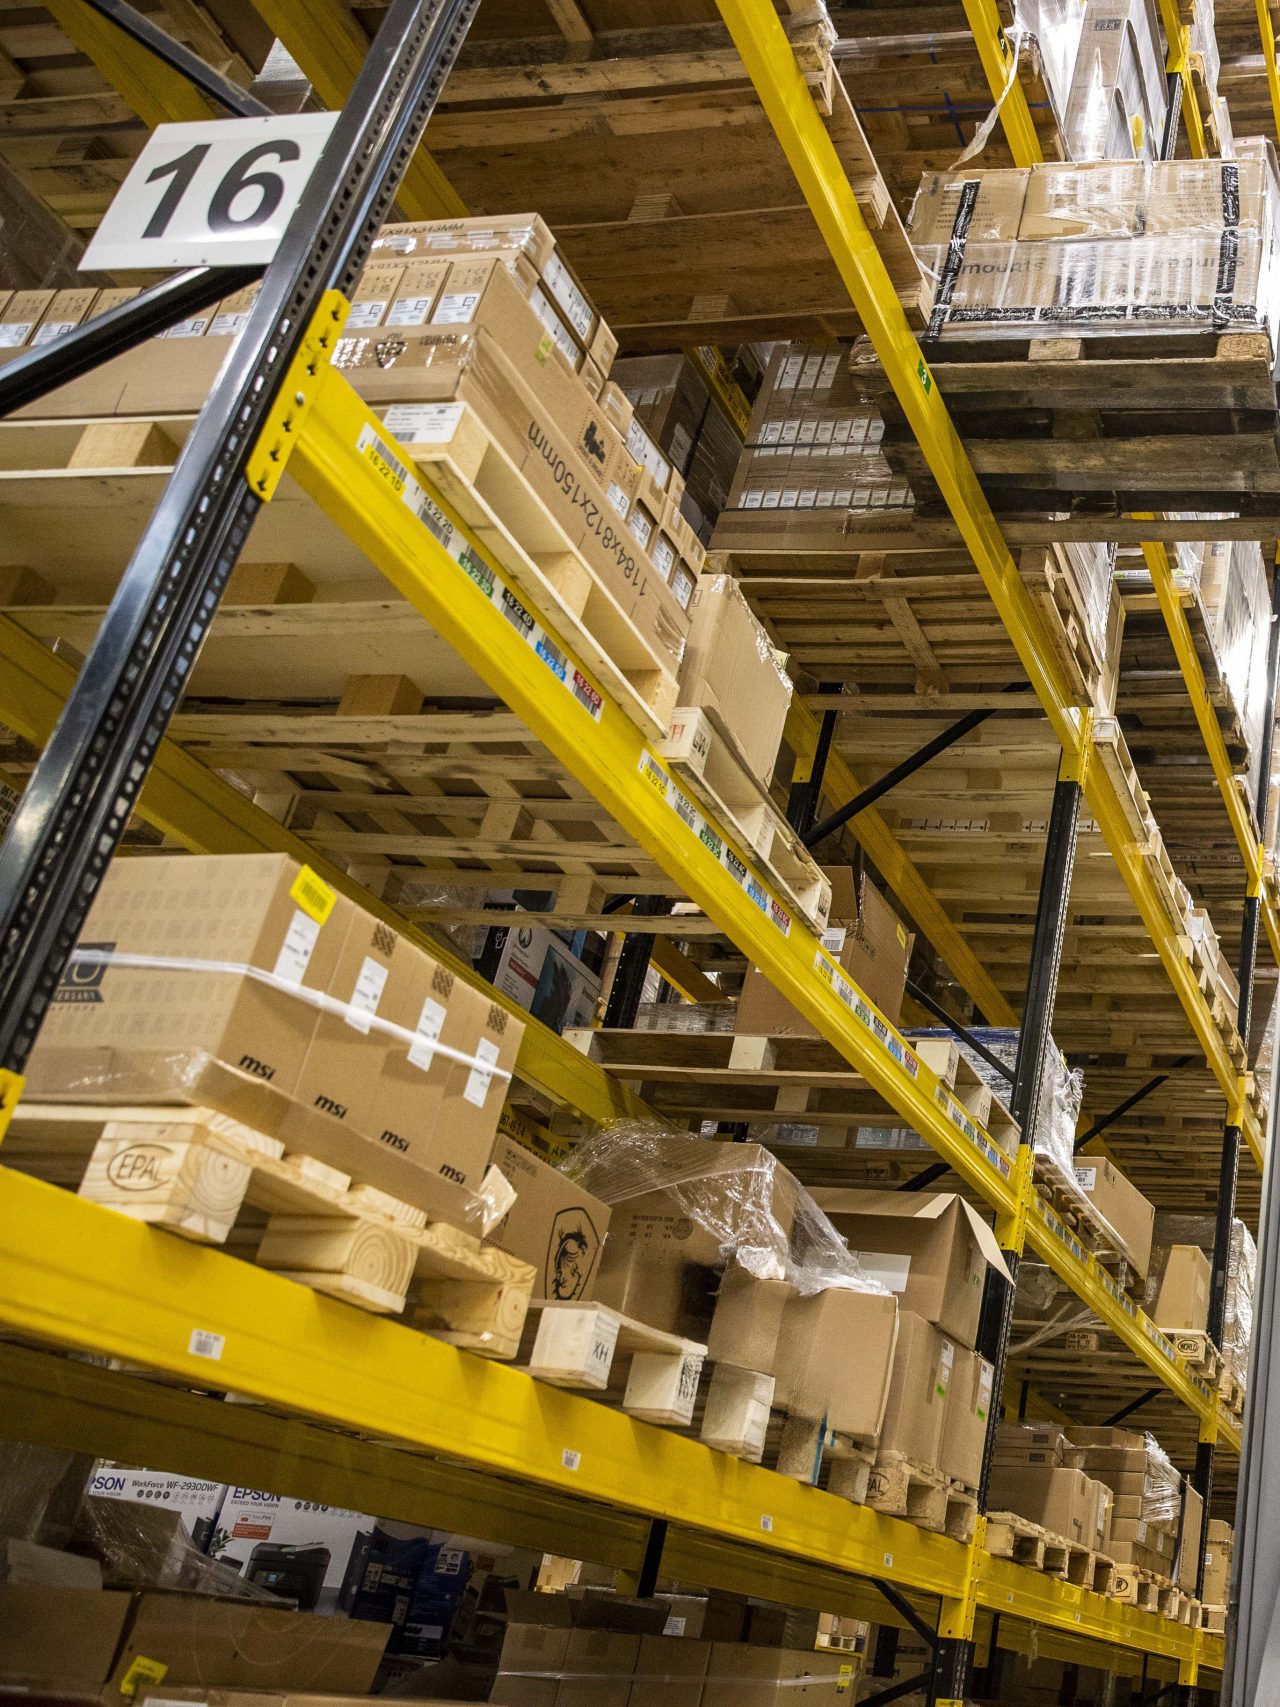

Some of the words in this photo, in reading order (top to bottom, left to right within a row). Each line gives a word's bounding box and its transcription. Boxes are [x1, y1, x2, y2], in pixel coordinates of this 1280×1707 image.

[142, 138, 301, 239] 16
[368, 449, 379, 467] 16
[379, 462, 390, 480] 22
[423, 495, 433, 512] 16
[433, 507, 443, 522] 22
[528, 420, 647, 597] 1184x812x150mm
[505, 592, 515, 608] 16
[514, 602, 523, 617] 22
[88, 917, 258, 942] ERFORMANCE
[238, 1054, 277, 1081] msi
[314, 1094, 348, 1120] msi
[380, 1129, 411, 1152] msi
[116, 1153, 162, 1182] EPAL
[439, 1164, 467, 1185] msi
[1180, 1342, 1199, 1351] WORLD
[93, 1476, 126, 1491] SON
[132, 1479, 165, 1490] WorkForce
[166, 1480, 219, 1492] WF-2930DWF
[868, 1478, 884, 1493] PAL
